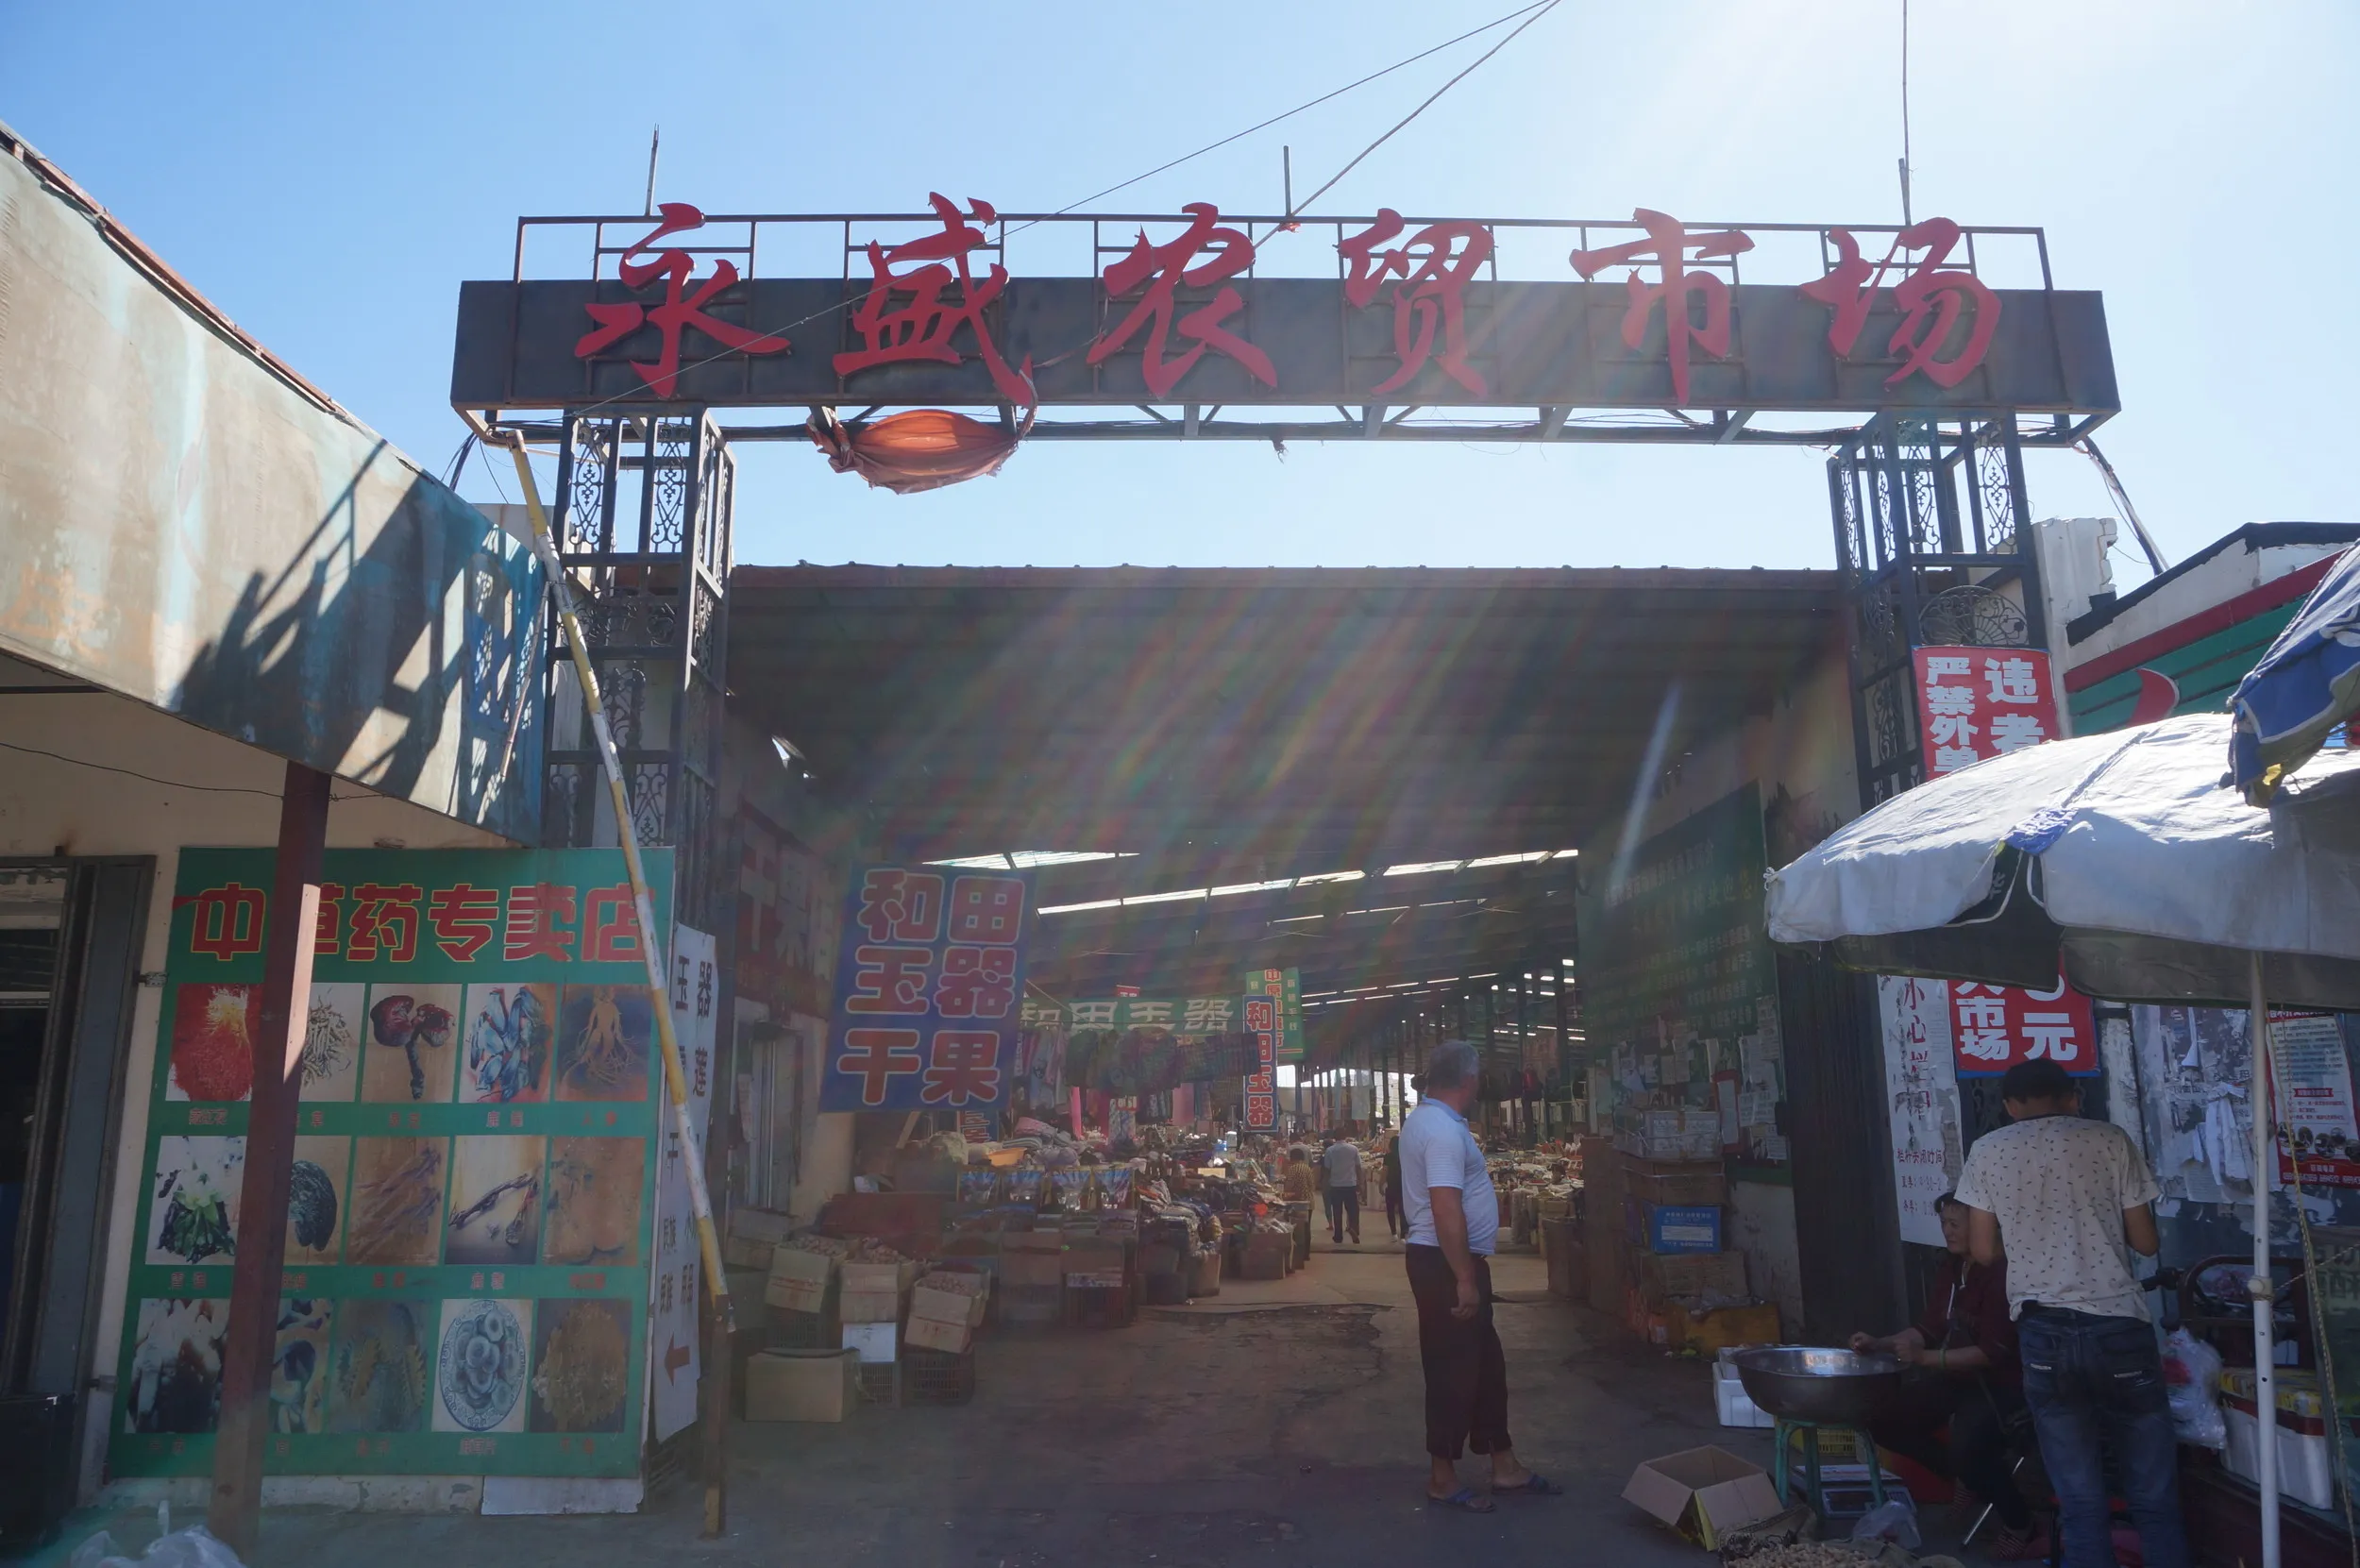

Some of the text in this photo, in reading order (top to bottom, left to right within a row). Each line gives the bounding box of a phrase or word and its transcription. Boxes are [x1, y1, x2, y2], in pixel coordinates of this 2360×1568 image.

[574, 191, 2003, 406] 永盛农贸市场
[1984, 657, 2045, 755] 违者
[856, 868, 1026, 946] 和田
[845, 945, 1018, 1019] 玉器
[2022, 974, 2079, 1061] 元
[836, 1027, 1001, 1106] 干果
[1247, 1001, 1273, 1127] 和田玉器
